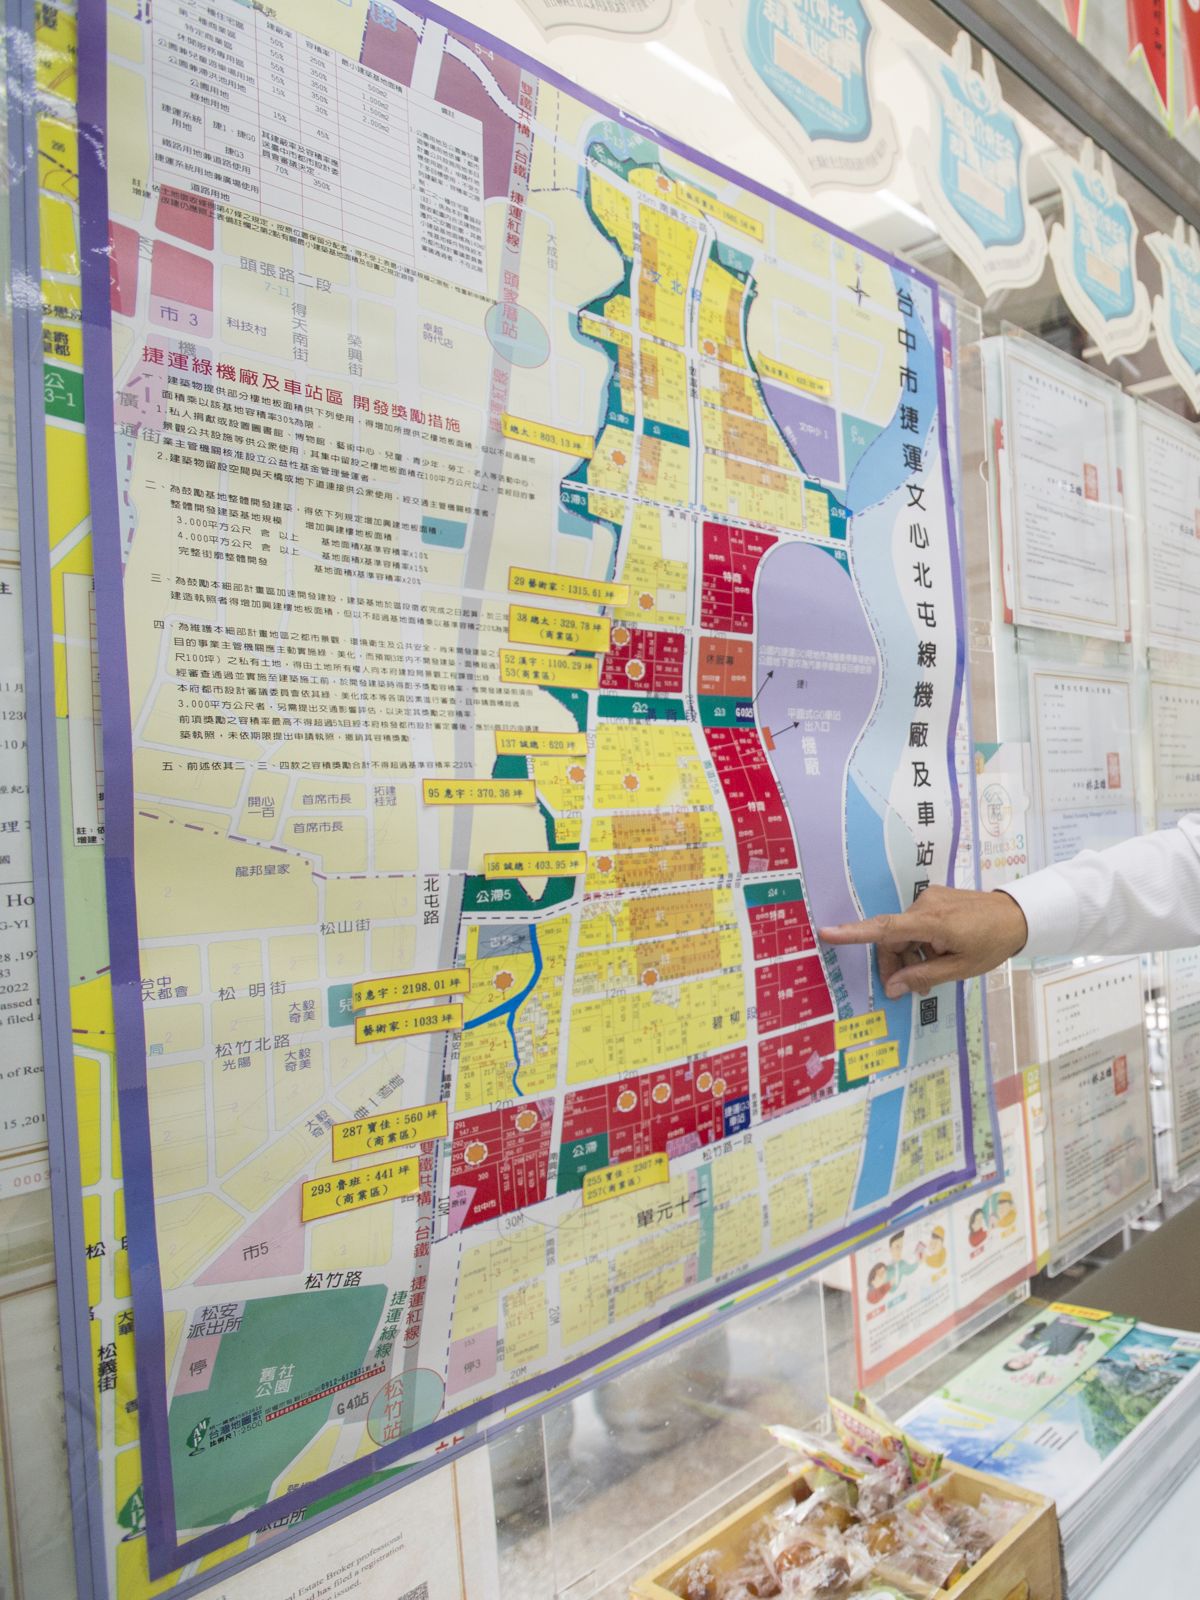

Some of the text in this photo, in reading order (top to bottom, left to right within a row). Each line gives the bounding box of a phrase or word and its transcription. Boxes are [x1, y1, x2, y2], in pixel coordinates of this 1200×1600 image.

[240, 256, 332, 294] 頭張路二段
[160, 305, 199, 328] 市 3
[226, 316, 267, 338] 科技村
[291, 301, 309, 363] 得天南街
[142, 345, 343, 406] 捷運綠機廠及車站區
[353, 394, 461, 433] 開發獎勵措施
[500, 738, 516, 748] 137
[247, 796, 275, 806] 開心
[302, 793, 352, 806] 首席市長
[428, 788, 440, 798] 95
[247, 808, 275, 818] 一百
[293, 821, 344, 834] 首席市長
[235, 863, 290, 877] 龍邦皇家
[423, 877, 440, 925] 北屯路
[319, 918, 371, 935] 松山街
[140, 975, 172, 987] 台中
[449, 978, 461, 988] 坪
[142, 985, 189, 1001] 大都會
[289, 999, 315, 1012] 大毅
[919, 996, 938, 1026] 圖
[441, 1014, 453, 1024] 坪
[215, 1033, 291, 1057] 松竹北路
[284, 1047, 311, 1061] 大毅
[7, 1067, 21, 1078] of
[222, 1056, 251, 1070] 光陽
[342, 1124, 363, 1139] 287
[427, 1108, 439, 1119] 坪
[366, 1127, 418, 1149] （商業區）
[311, 1181, 332, 1197] 293
[398, 1164, 410, 1177] 坪
[335, 1184, 389, 1207] （商業區）
[86, 1241, 106, 1260] 松
[242, 1241, 270, 1261] 市5
[304, 1270, 363, 1290] 松竹路
[201, 1303, 238, 1321] 松安
[187, 1316, 243, 1340] 派出所
[374, 1290, 408, 1360] 捷運綠線
[96, 1342, 118, 1394] 松義街
[188, 1358, 208, 1377] 停
[255, 1378, 292, 1398] 公園
[336, 1391, 370, 1415] G4站
[383, 1379, 404, 1443] 松竹站
